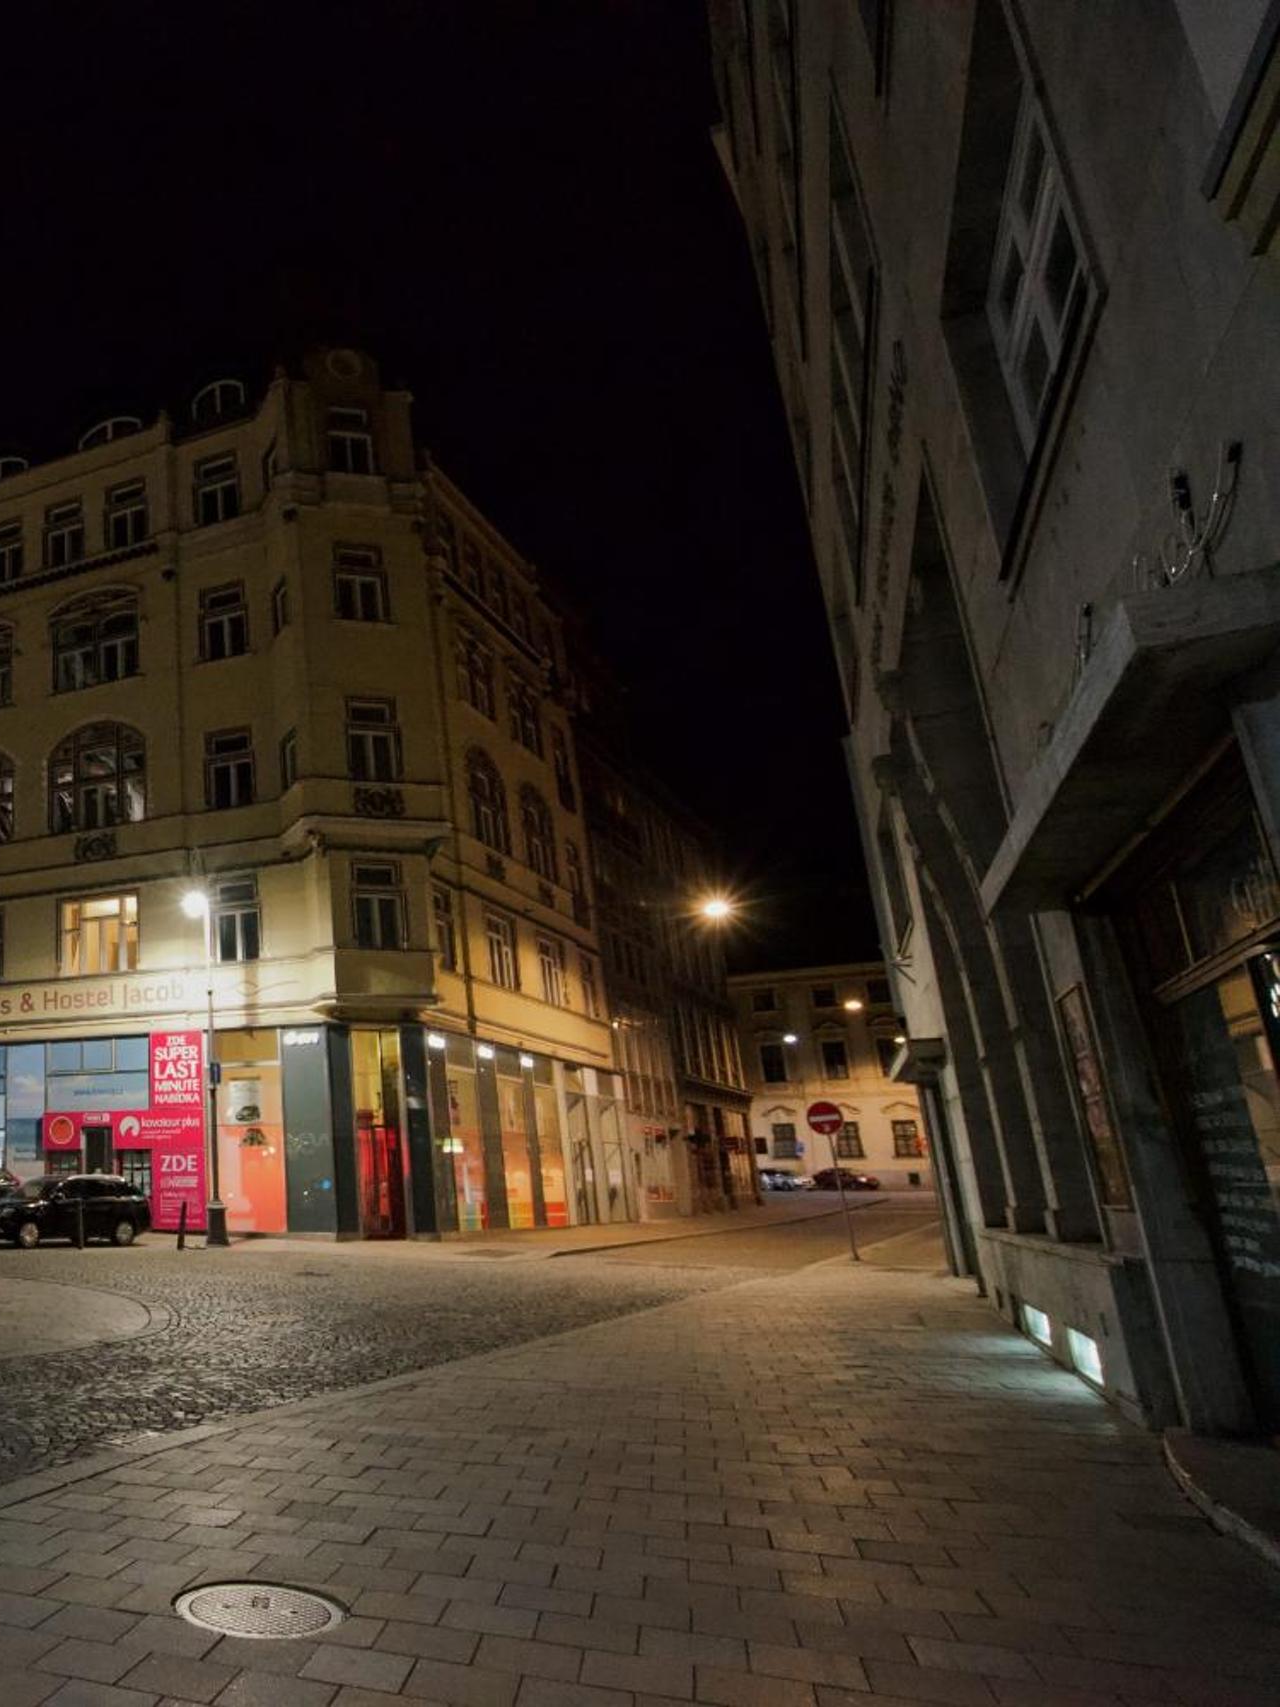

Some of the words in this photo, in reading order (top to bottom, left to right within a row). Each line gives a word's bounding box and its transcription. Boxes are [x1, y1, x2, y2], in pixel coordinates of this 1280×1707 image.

[20, 992, 34, 1012] &
[43, 985, 114, 1010] Hostel
[123, 980, 184, 1010] Jacob
[155, 1046, 198, 1060] SUPER
[154, 1061, 199, 1079] LAST
[155, 1079, 200, 1092] MINUTE
[160, 1155, 198, 1172] ZDE
